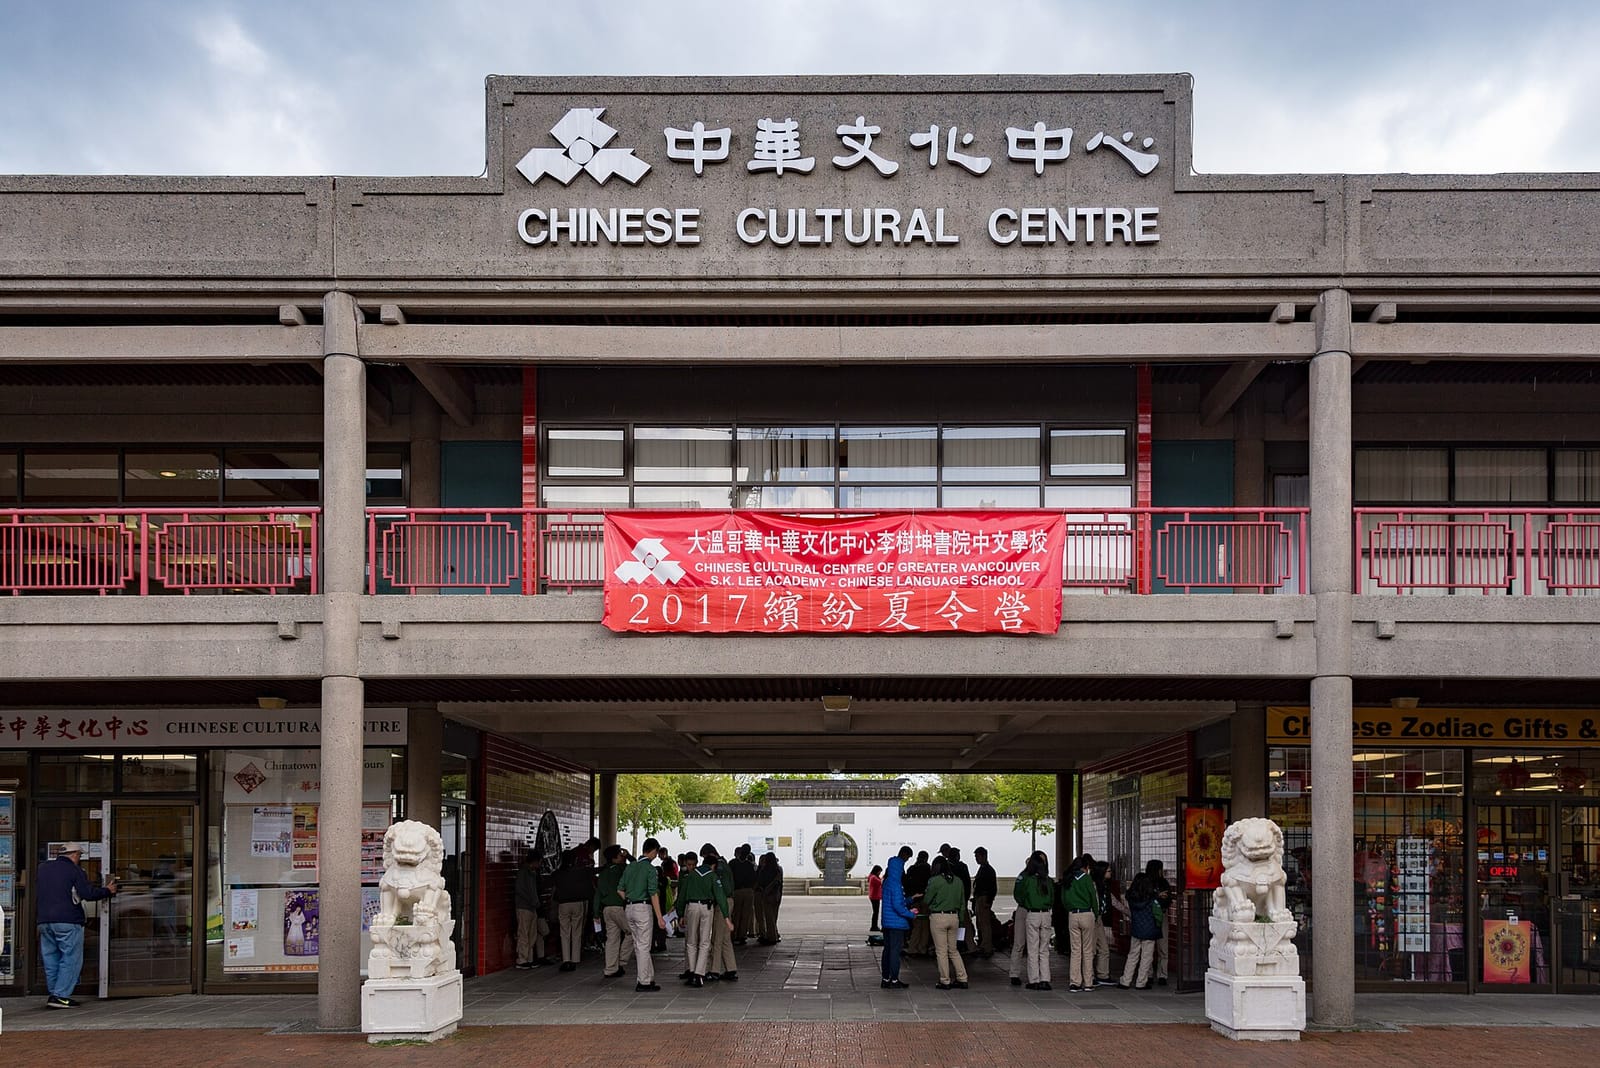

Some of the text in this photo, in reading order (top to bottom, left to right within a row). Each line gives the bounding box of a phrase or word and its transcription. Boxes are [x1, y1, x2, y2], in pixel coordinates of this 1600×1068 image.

[663, 115, 1160, 178] 中華文化中心
[517, 207, 1161, 246] CHINESE CULTURAL CENTRE
[687, 529, 1049, 556] 大溫哥華中華文化中心李樹坤書院中文學校
[695, 561, 1041, 575] CHINESE CULTURAL CENTRE OF GREATER VANCOUVER
[710, 576, 735, 586] S.K.
[738, 576, 762, 586] LEE
[765, 576, 827, 588] ACADEMY
[838, 576, 893, 587] CHINESE
[896, 575, 968, 587] LANGUAGE
[971, 575, 1025, 587] SCHOOL
[166, 721, 239, 734] CHINESE
[242, 721, 321, 734] CULTURA
[1283, 716, 1598, 739] Chese Zodiac Gifts &
[264, 759, 385, 771] Chinatown ours
[1489, 866, 1518, 877] OPEN
